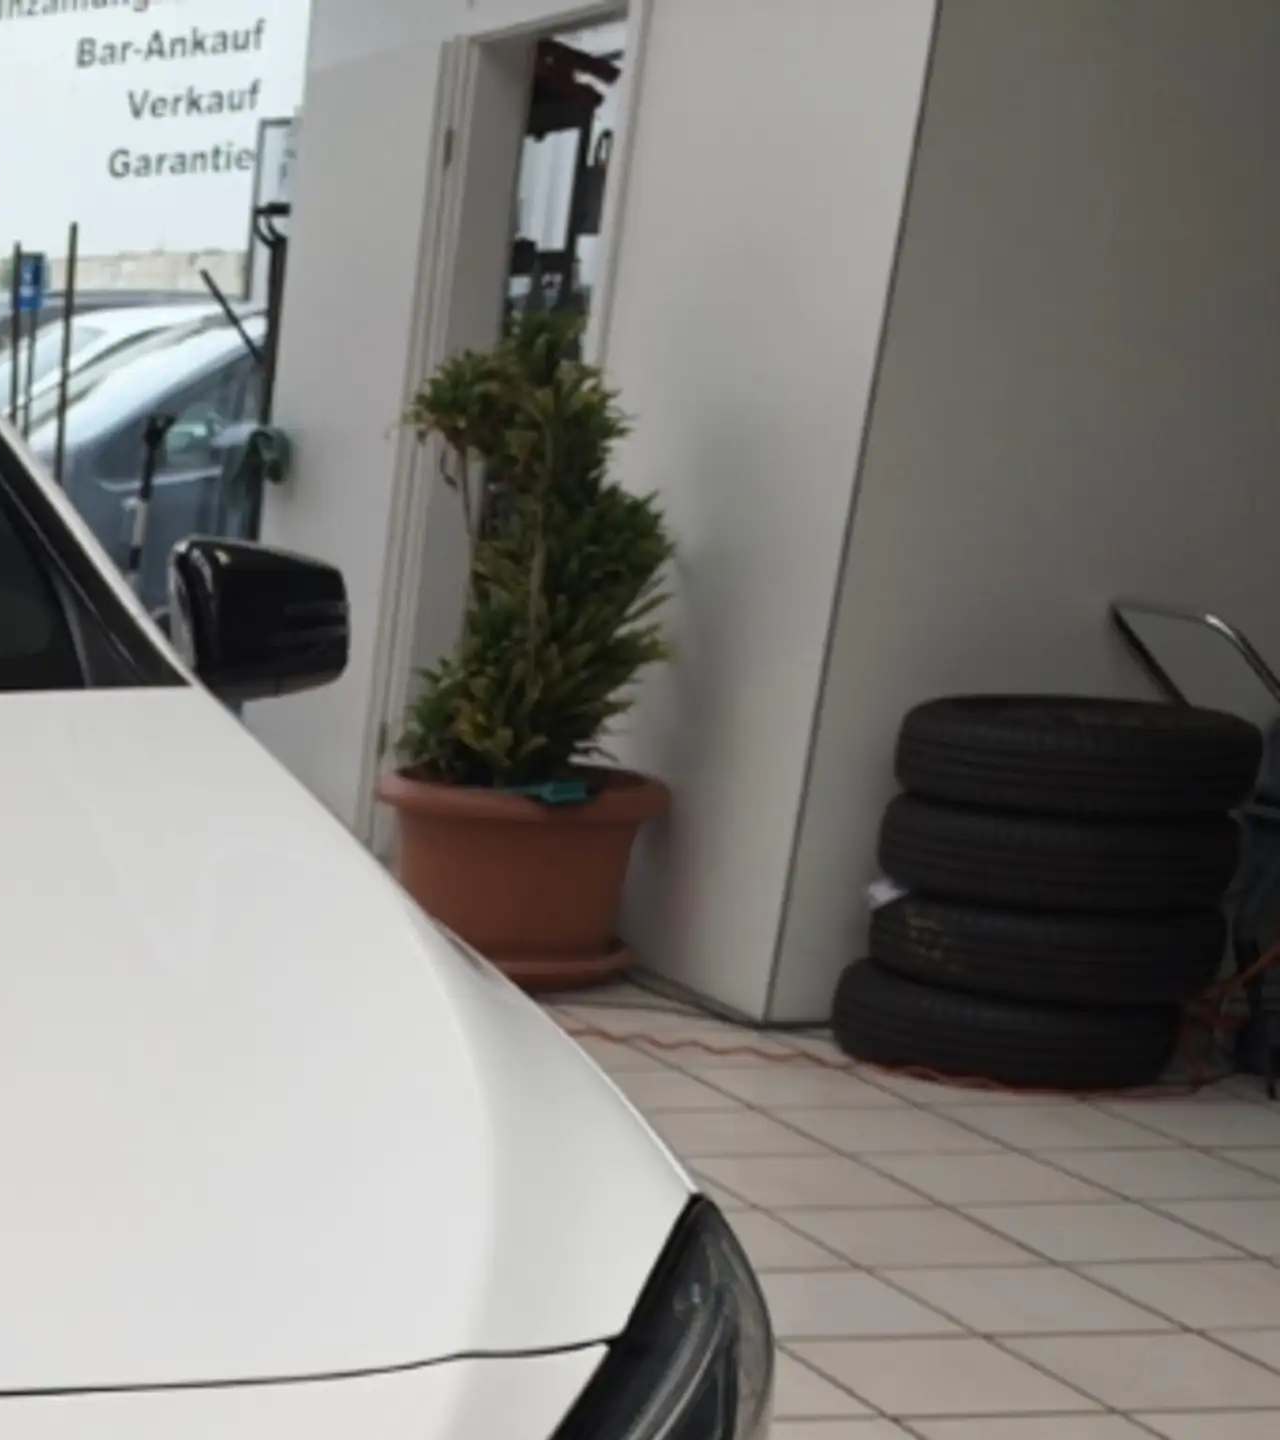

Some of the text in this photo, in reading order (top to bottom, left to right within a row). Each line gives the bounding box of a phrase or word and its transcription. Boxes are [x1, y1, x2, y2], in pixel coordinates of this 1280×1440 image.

[75, 18, 265, 68] Bar-Ankauf
[127, 79, 262, 120] Verkauf
[107, 142, 257, 179] Garantie
